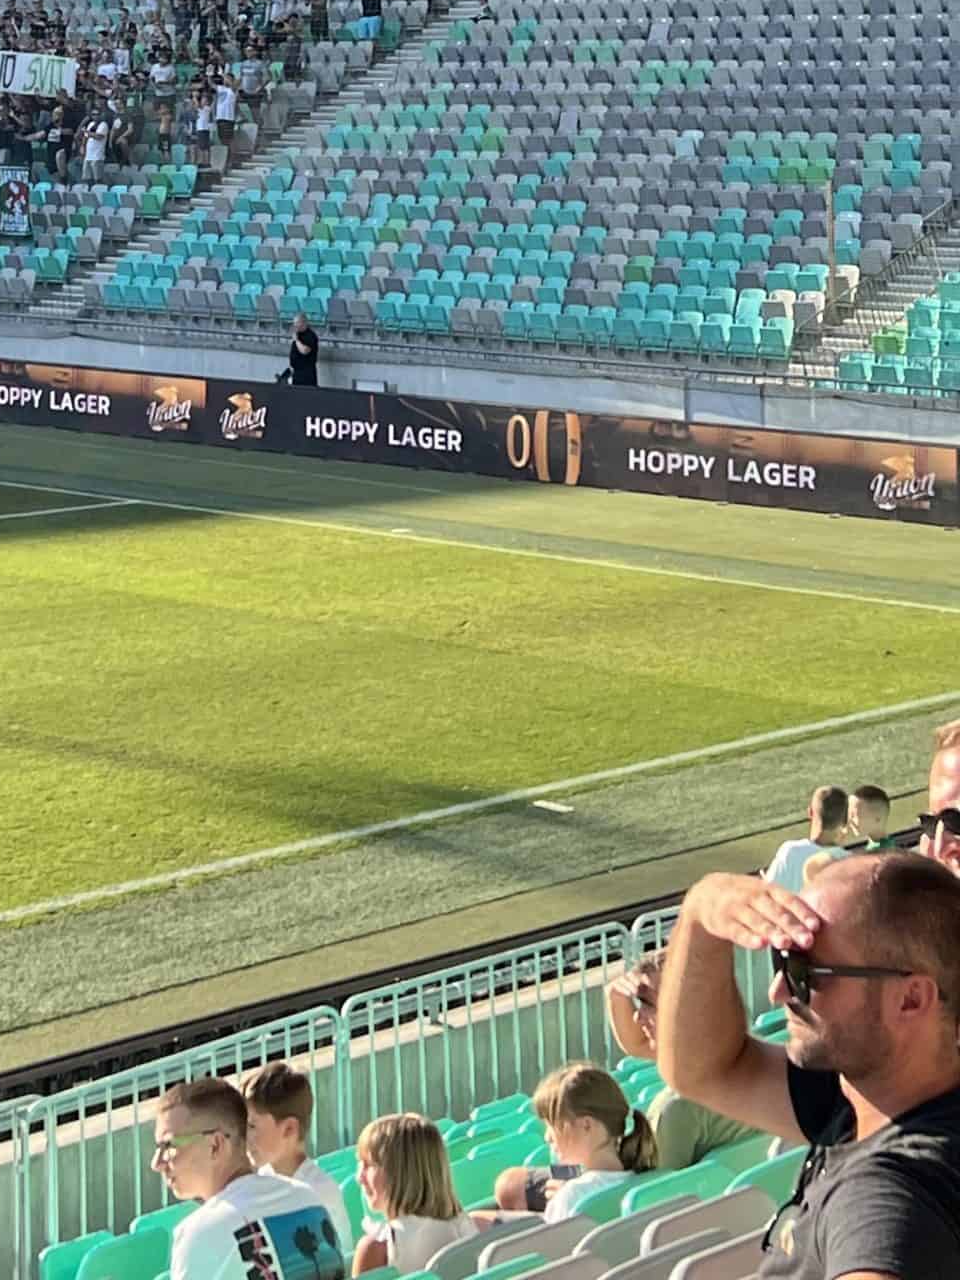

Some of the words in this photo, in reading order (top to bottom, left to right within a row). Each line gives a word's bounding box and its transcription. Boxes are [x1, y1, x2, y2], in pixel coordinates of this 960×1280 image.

[49, 390, 110, 416] LAGER
[305, 416, 378, 443] HOPPY
[387, 423, 462, 453] LAGER
[628, 448, 717, 480] HOPPY
[727, 457, 817, 491] LAGER
